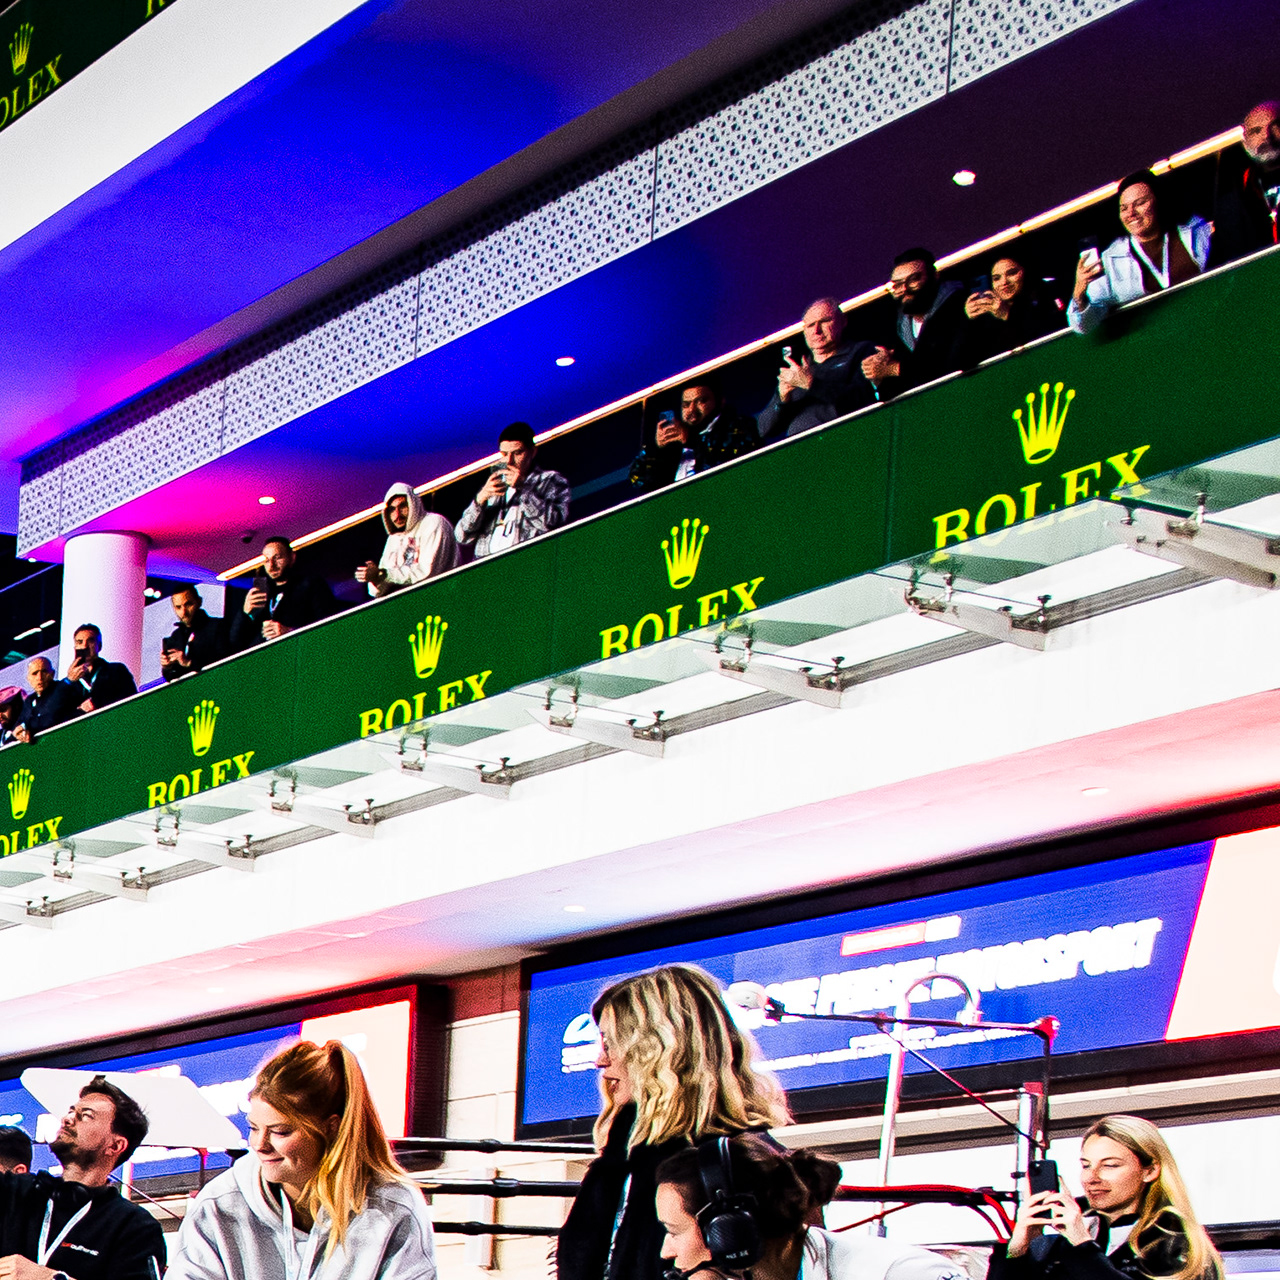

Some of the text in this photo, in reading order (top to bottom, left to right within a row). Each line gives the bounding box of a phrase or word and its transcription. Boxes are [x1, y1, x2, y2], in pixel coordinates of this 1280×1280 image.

[929, 444, 1152, 564] ROLEX
[599, 576, 766, 661] ROLEX
[359, 669, 493, 738] ROLEX
[147, 750, 256, 813] ROLEX
